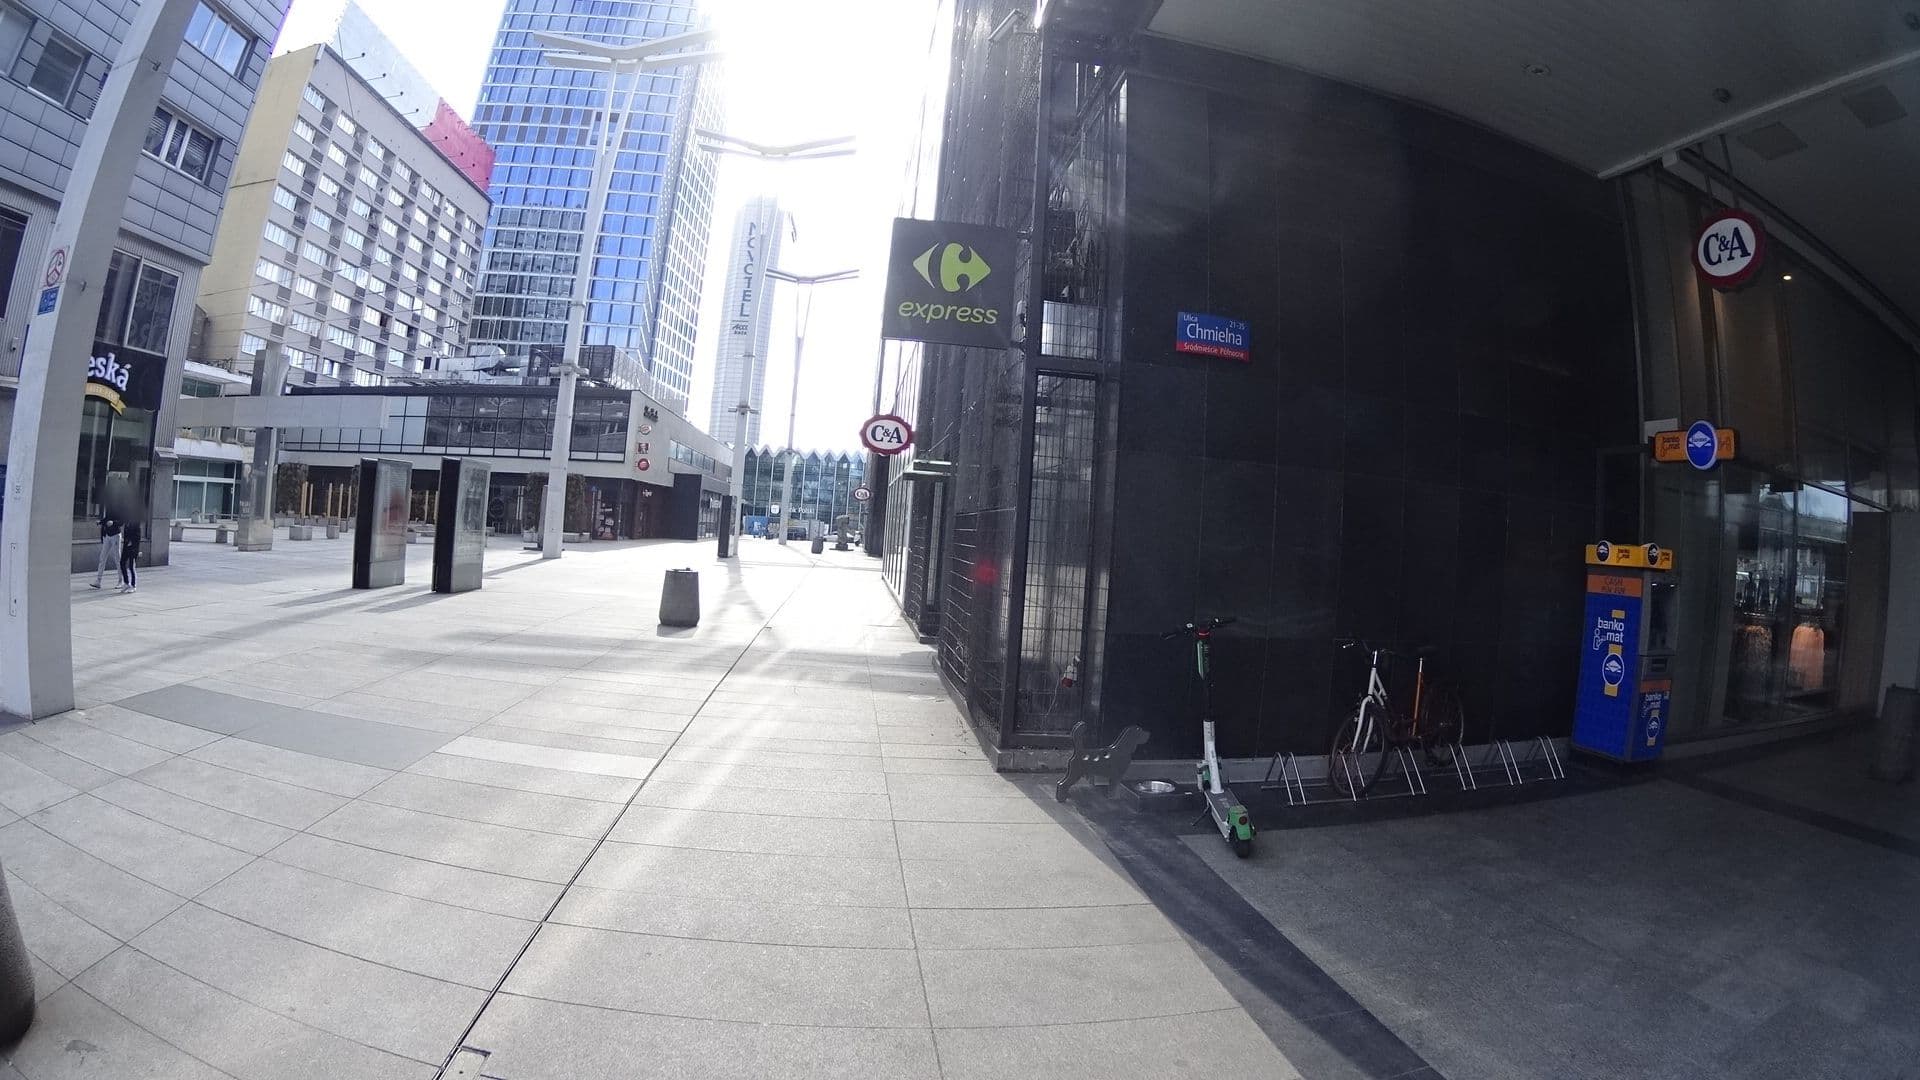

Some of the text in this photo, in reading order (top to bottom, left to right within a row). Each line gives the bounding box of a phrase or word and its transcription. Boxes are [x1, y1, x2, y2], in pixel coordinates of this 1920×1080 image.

[1702, 226, 1752, 266] C&A
[898, 301, 998, 325] express
[1187, 323, 1242, 345] Chmielna
[87, 352, 132, 392] eská
[870, 424, 904, 444] C&A
[1597, 616, 1625, 631] banko
[1606, 632, 1624, 643] mat
